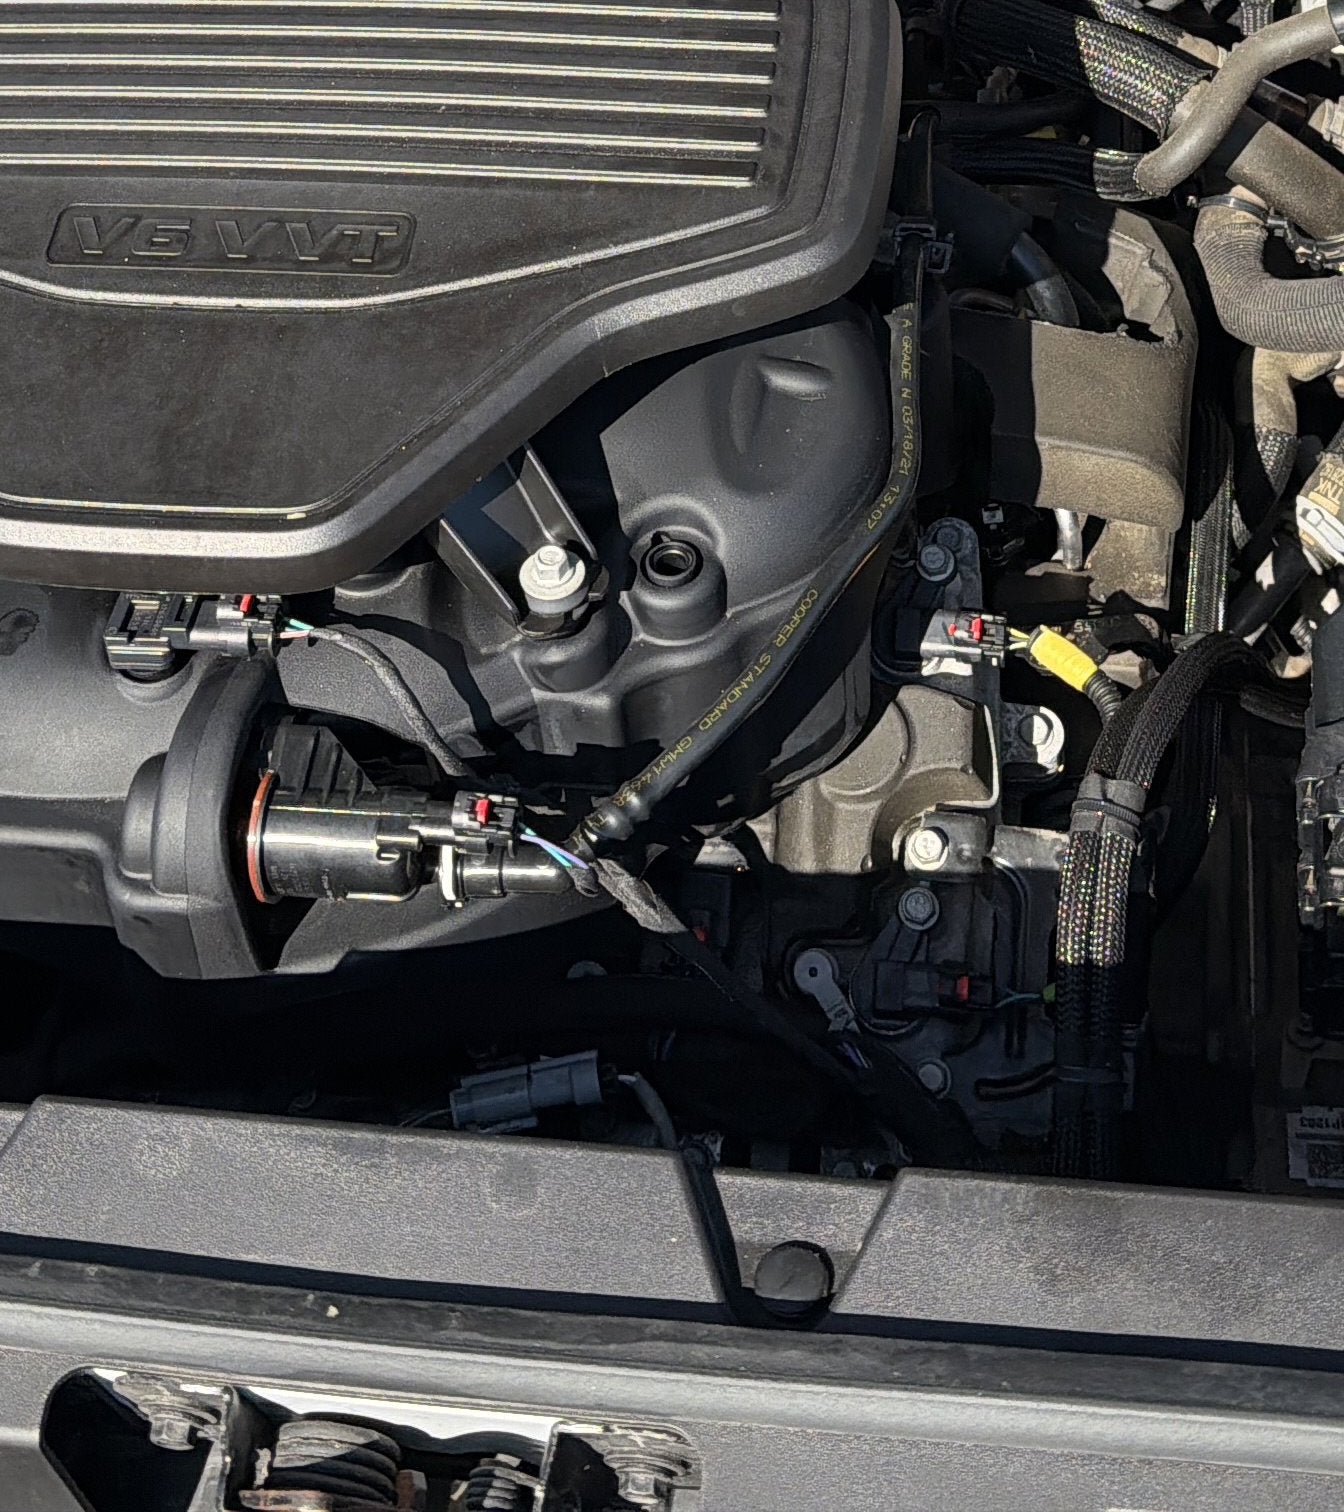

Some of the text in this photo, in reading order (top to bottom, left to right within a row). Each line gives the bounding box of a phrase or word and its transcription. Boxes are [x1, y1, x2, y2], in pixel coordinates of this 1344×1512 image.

[73, 216, 400, 263] V6 VVT
[901, 335, 913, 381] GRADE
[899, 405, 914, 476] 03/18/21
[1313, 477, 1344, 505] TNK
[773, 589, 818, 647] COOPER
[699, 653, 772, 731] STANDARD
